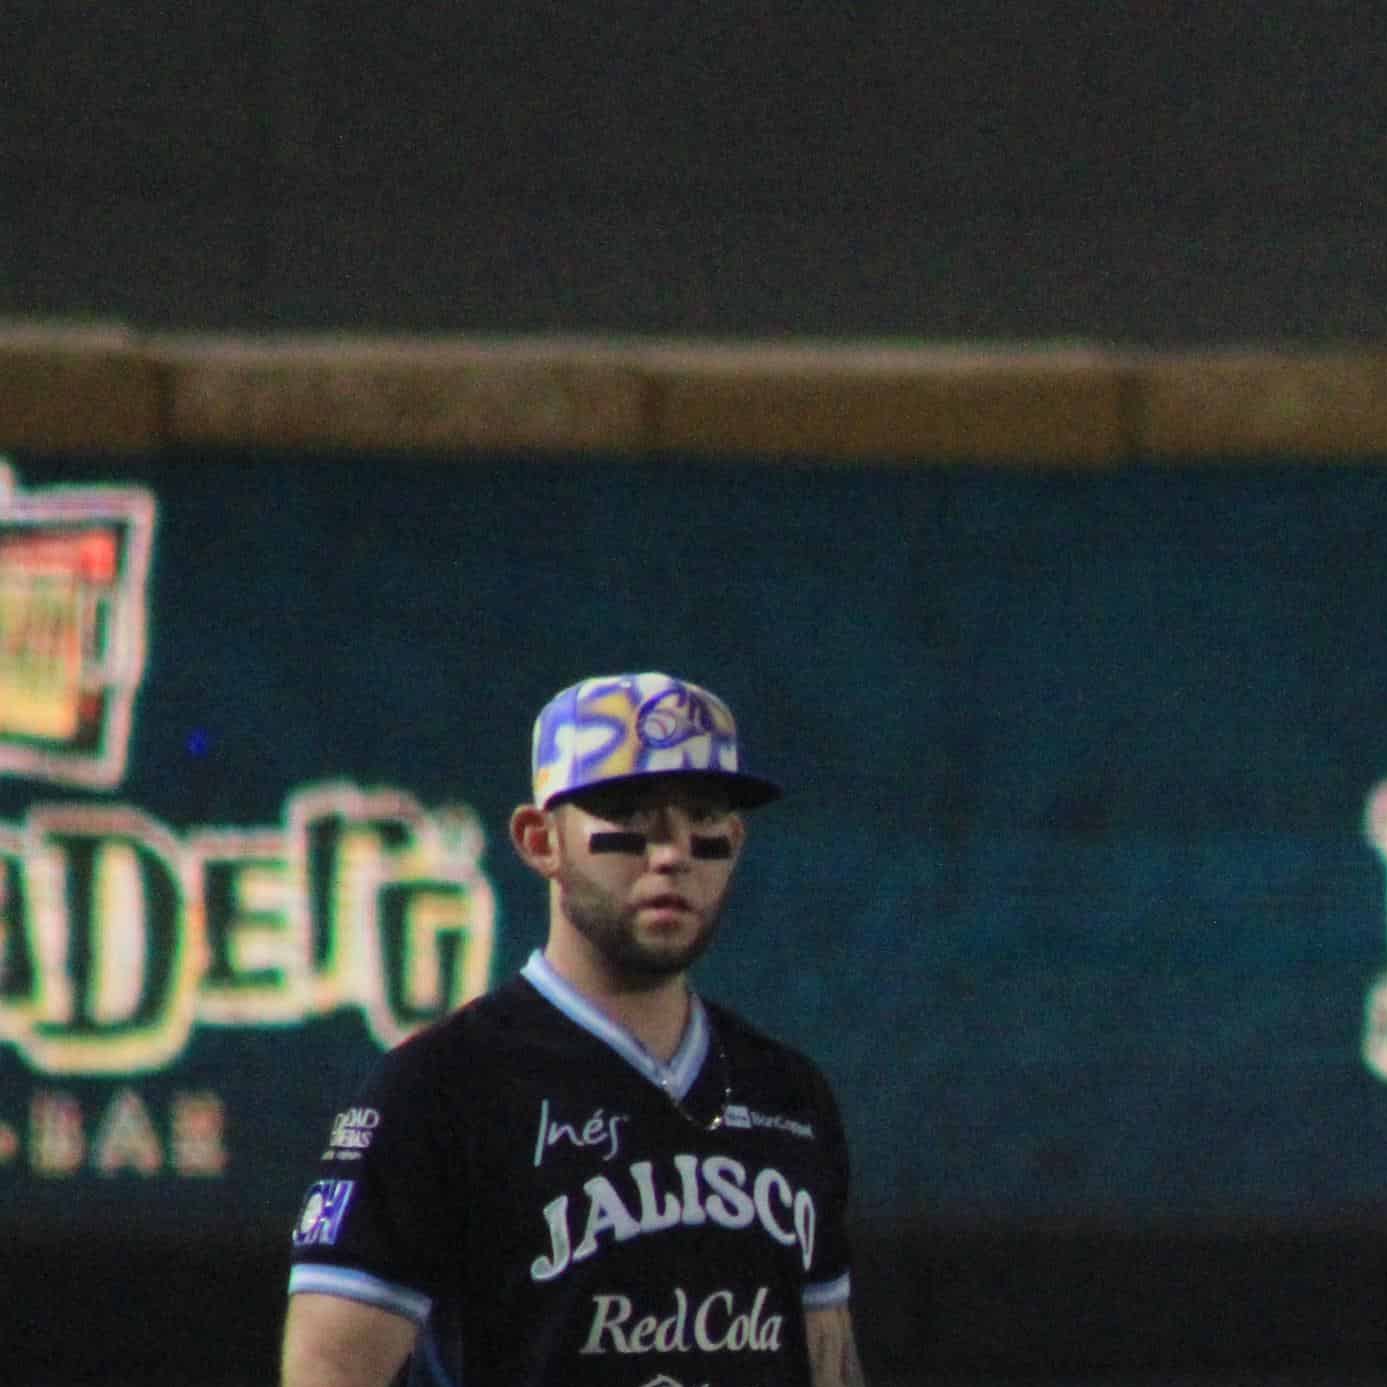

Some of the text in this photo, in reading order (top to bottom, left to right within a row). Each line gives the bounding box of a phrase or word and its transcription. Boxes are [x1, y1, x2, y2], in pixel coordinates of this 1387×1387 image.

[531, 1155, 816, 1282] JALISCO
[580, 1287, 782, 1355] Red Cola
